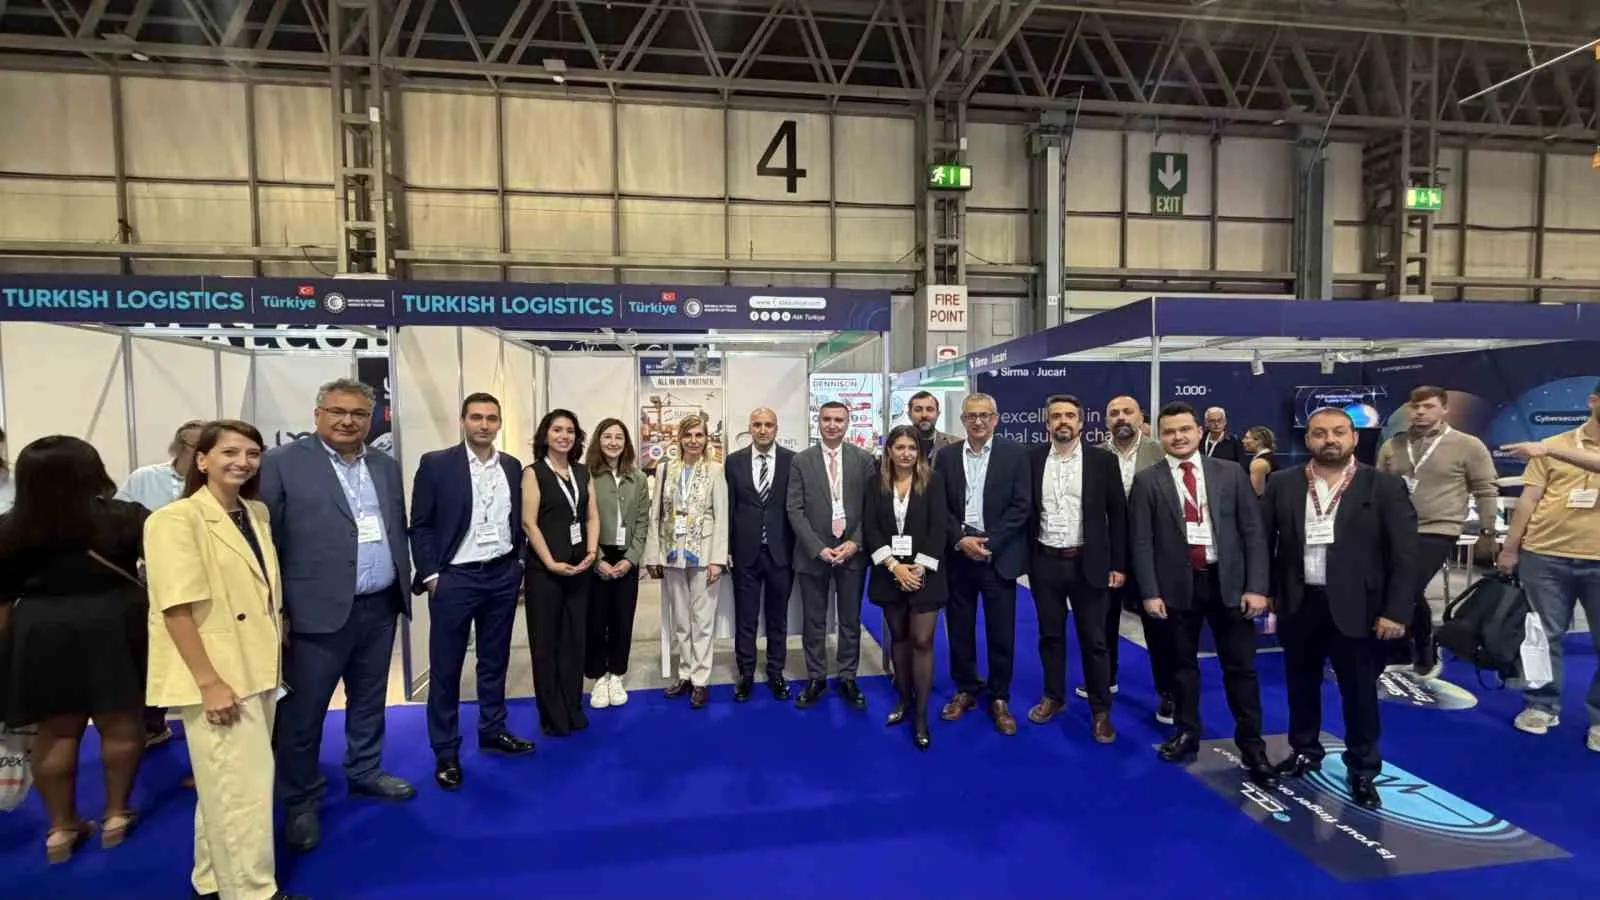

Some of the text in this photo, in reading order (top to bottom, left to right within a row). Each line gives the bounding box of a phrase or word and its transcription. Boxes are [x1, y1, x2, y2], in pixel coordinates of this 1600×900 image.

[757, 121, 807, 193] 4
[1156, 196, 1181, 212] EXIT
[2, 288, 245, 310] TURKISH LOGISTICS
[261, 296, 317, 310] Türkiye
[402, 294, 495, 314] TURKISH
[502, 296, 614, 315] LOGISTICS
[935, 294, 961, 306] FIRE
[628, 301, 677, 315] Türkiye
[930, 310, 965, 322] POINT
[1000, 367, 1029, 377] Sirma
[1087, 408, 1100, 423] in
[1293, 796, 1339, 824] finger
[1336, 823, 1381, 847] your
[1376, 847, 1396, 860] Is
